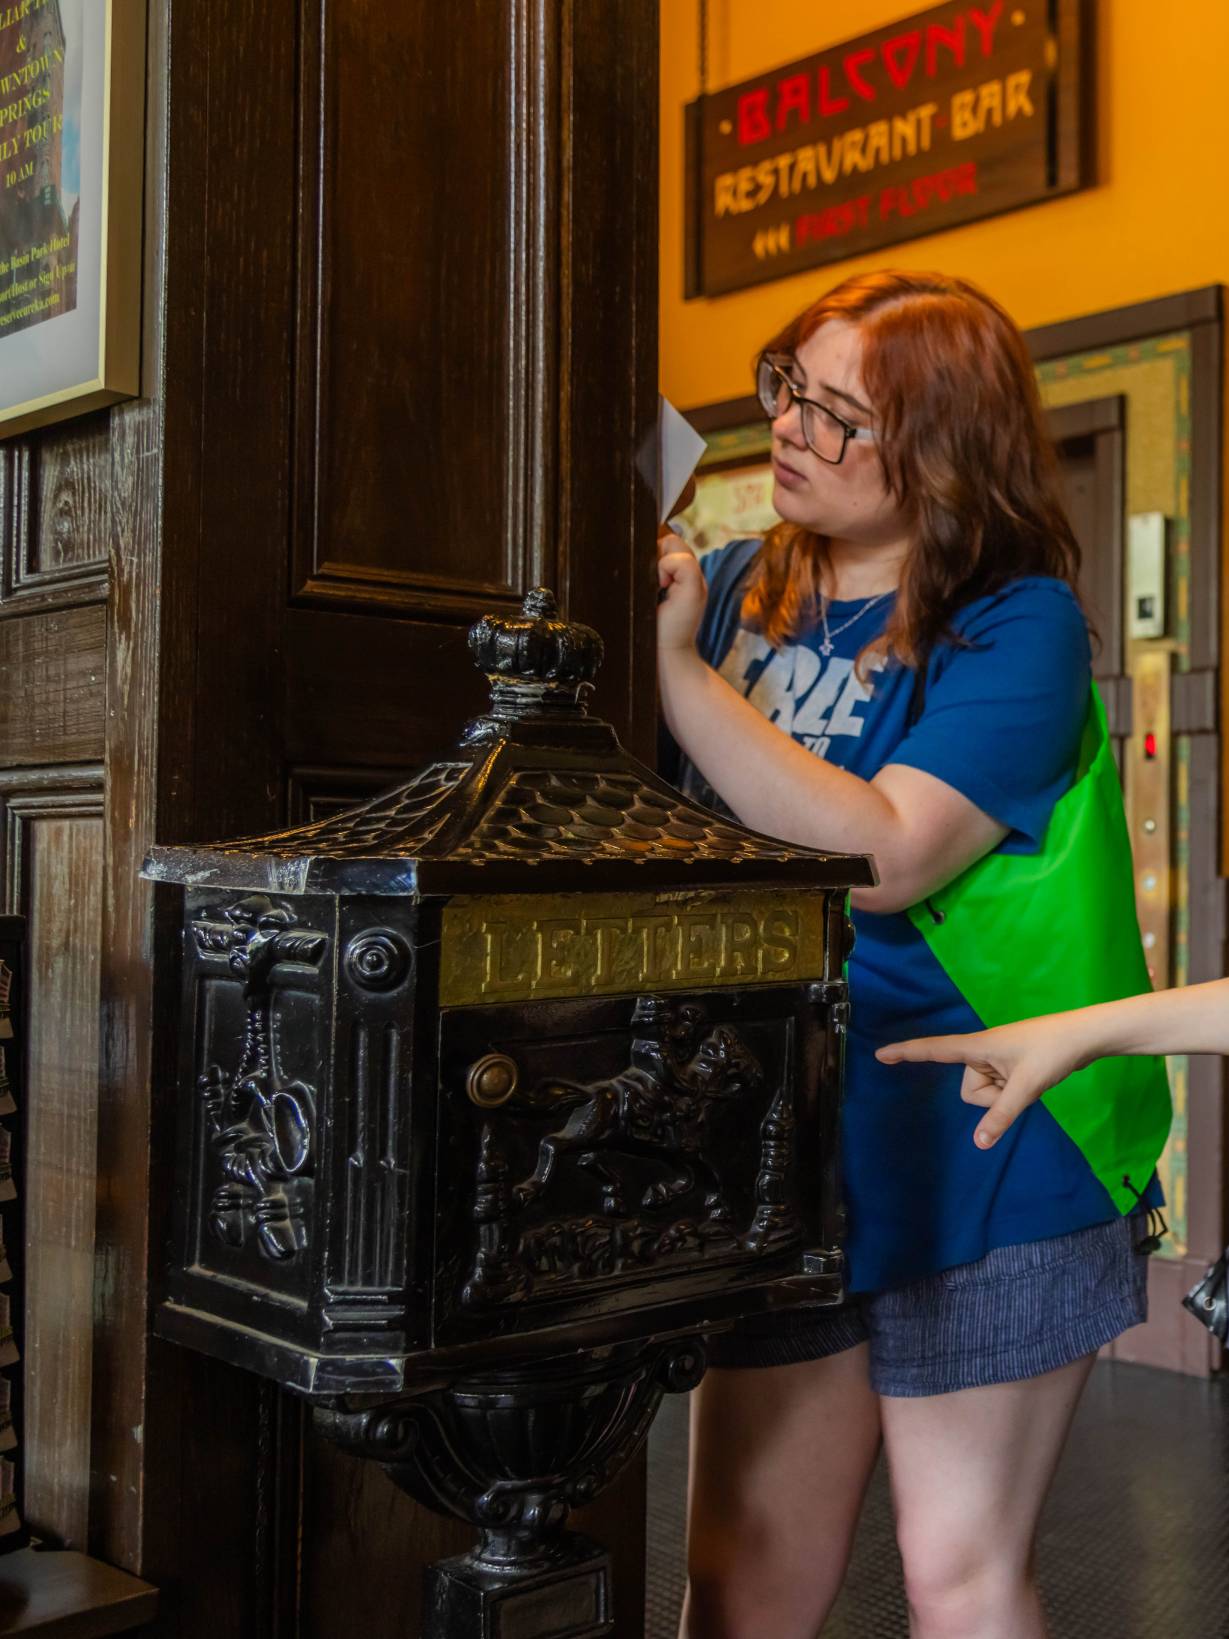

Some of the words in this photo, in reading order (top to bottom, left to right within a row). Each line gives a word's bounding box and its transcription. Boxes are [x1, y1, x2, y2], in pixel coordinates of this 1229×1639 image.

[16, 34, 26, 53] &
[737, 1, 1004, 147] BALCONY
[24, 113, 63, 149] TOUR
[950, 69, 1035, 142] BAR
[6, 170, 16, 188] 10
[18, 160, 33, 181] AM
[795, 195, 870, 247] FIRST
[879, 162, 978, 219] FLOOR
[31, 243, 48, 261] Park
[49, 231, 70, 253] Hotel
[482, 910, 800, 993] LETTERS
